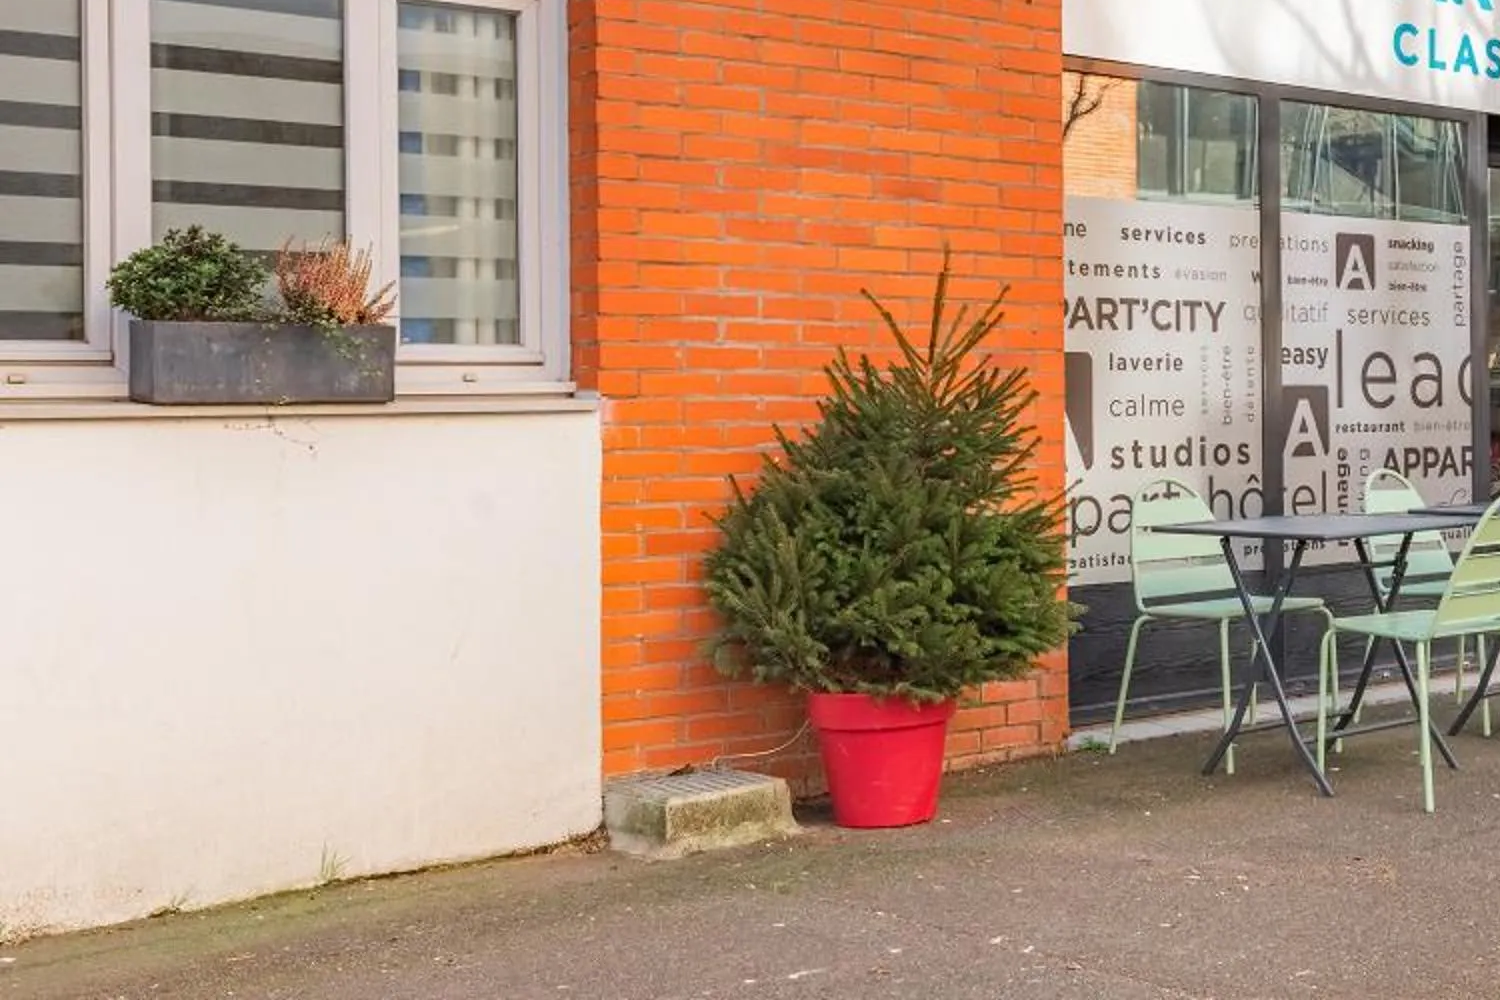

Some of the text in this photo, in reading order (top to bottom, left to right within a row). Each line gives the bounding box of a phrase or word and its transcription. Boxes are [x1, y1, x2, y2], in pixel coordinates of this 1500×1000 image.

[1119, 225, 1207, 246] services
[1067, 258, 1162, 280] tements
[1452, 240, 1467, 328] partage
[1063, 295, 1228, 334] ART'CITY
[1346, 303, 1432, 327] services
[1108, 351, 1184, 373] laverie
[1281, 346, 1330, 370] easy
[1108, 393, 1186, 418] calme
[1334, 420, 1406, 434] restaurant
[1110, 435, 1252, 470] studios
